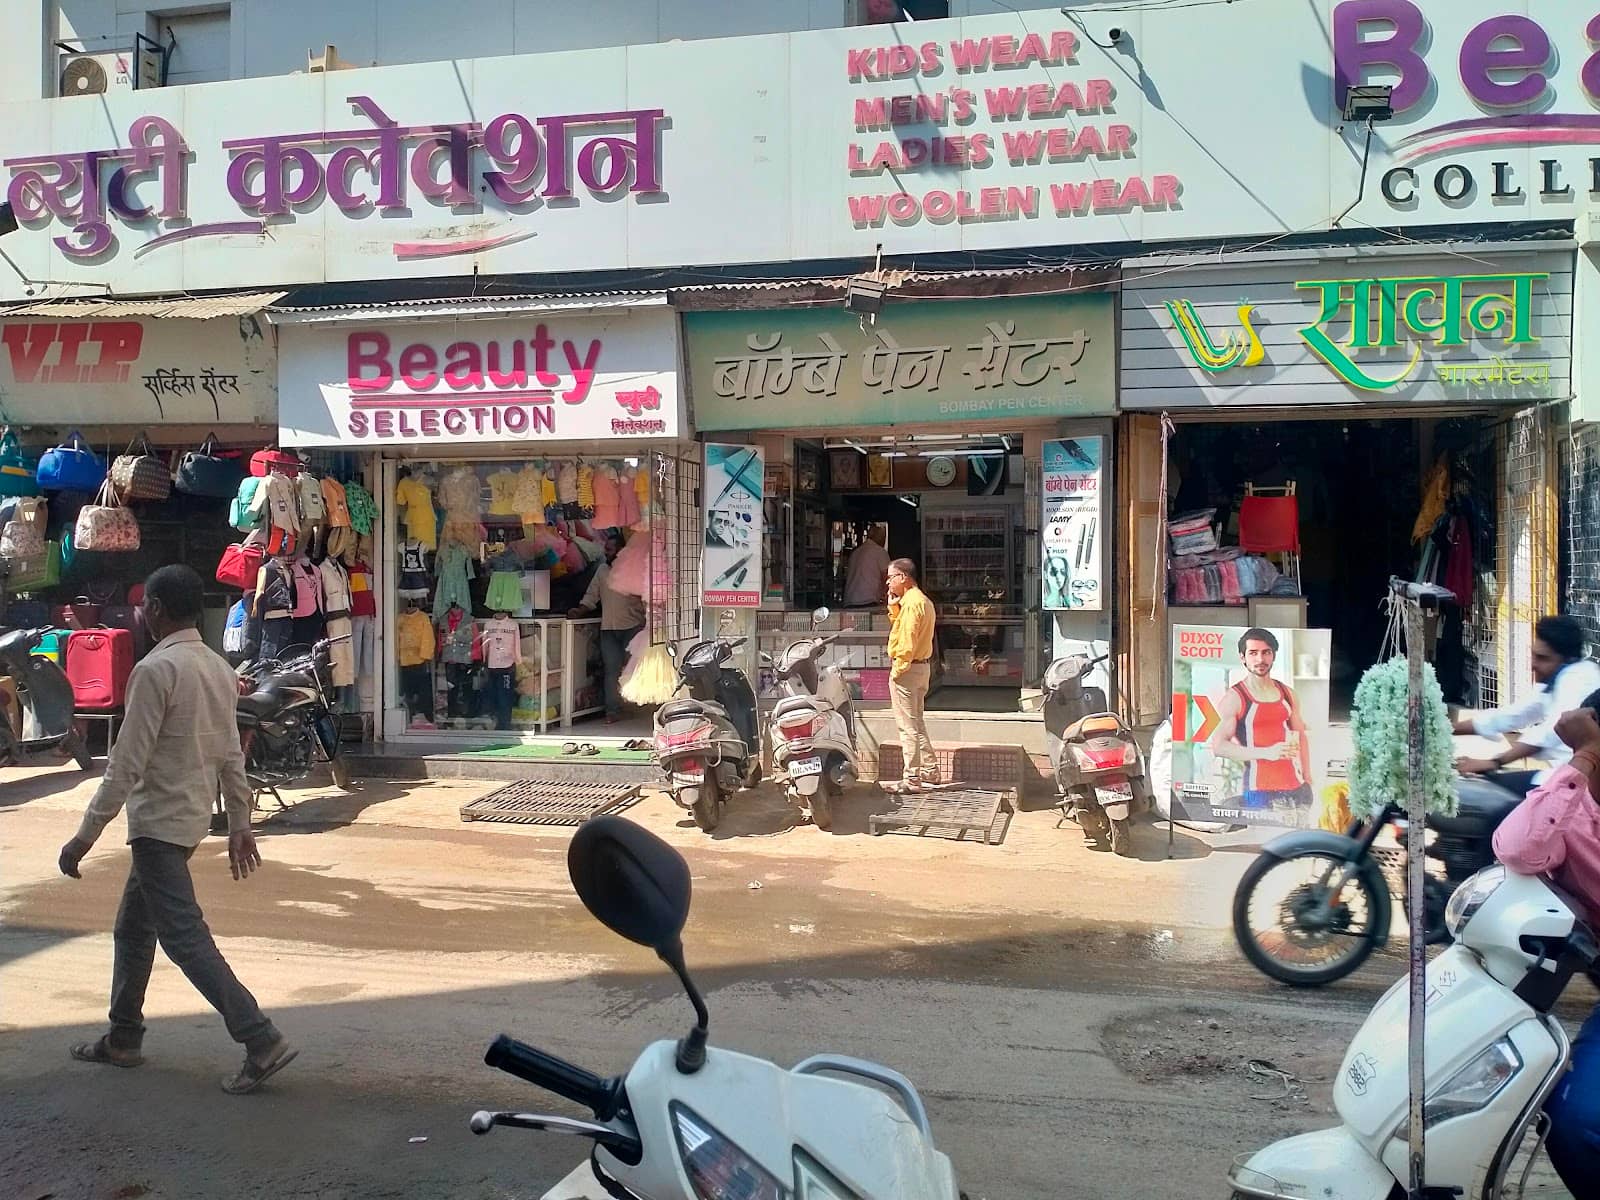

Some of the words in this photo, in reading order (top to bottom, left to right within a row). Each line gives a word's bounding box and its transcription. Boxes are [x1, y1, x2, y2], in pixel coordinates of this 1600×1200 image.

[848, 43, 938, 80] KIDS
[952, 31, 1077, 71] WEAR
[1333, 0, 1600, 115] Be
[854, 87, 974, 129] MEN'S
[985, 79, 1114, 118] WEAR
[848, 133, 991, 174] LADIES
[1002, 124, 1134, 162] WEAR
[848, 186, 1038, 226] WOOLEN
[1051, 175, 1180, 215] WEAR
[1381, 155, 1600, 204] COLL
[2, 322, 143, 383] VIP
[1295, 273, 1550, 390] सावन
[347, 324, 602, 404] Beauty
[714, 332, 848, 400] बॉम्बे
[862, 329, 951, 393] पेन
[963, 320, 1091, 390] सेंटर
[199, 367, 241, 420] सेंटर
[939, 400, 995, 414] BOMBAY
[997, 397, 1025, 411] PEN
[1027, 395, 1083, 410] CENTER
[348, 405, 554, 437] SELECTION
[1064, 475, 1077, 492] पेन
[1049, 515, 1072, 523] LAMY
[705, 594, 725, 602] BOMBAY
[1180, 631, 1224, 645] DIXCY
[1180, 646, 1223, 659] SCOTT
